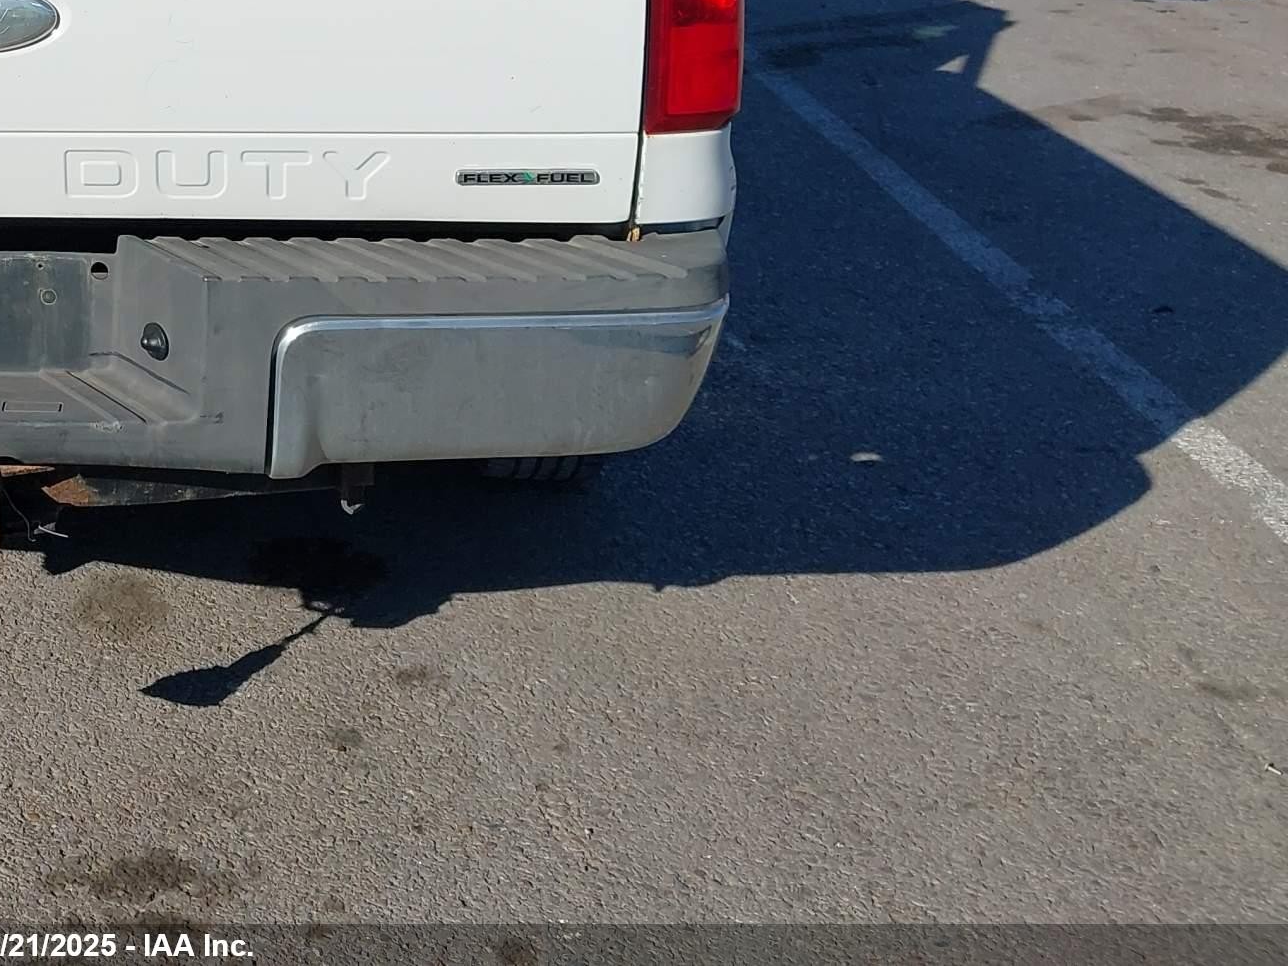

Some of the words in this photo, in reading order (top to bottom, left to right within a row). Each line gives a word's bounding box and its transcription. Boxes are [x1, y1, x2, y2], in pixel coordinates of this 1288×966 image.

[64, 149, 392, 200] DUTY
[463, 172, 519, 183] FLEX
[536, 172, 594, 183] FUEL
